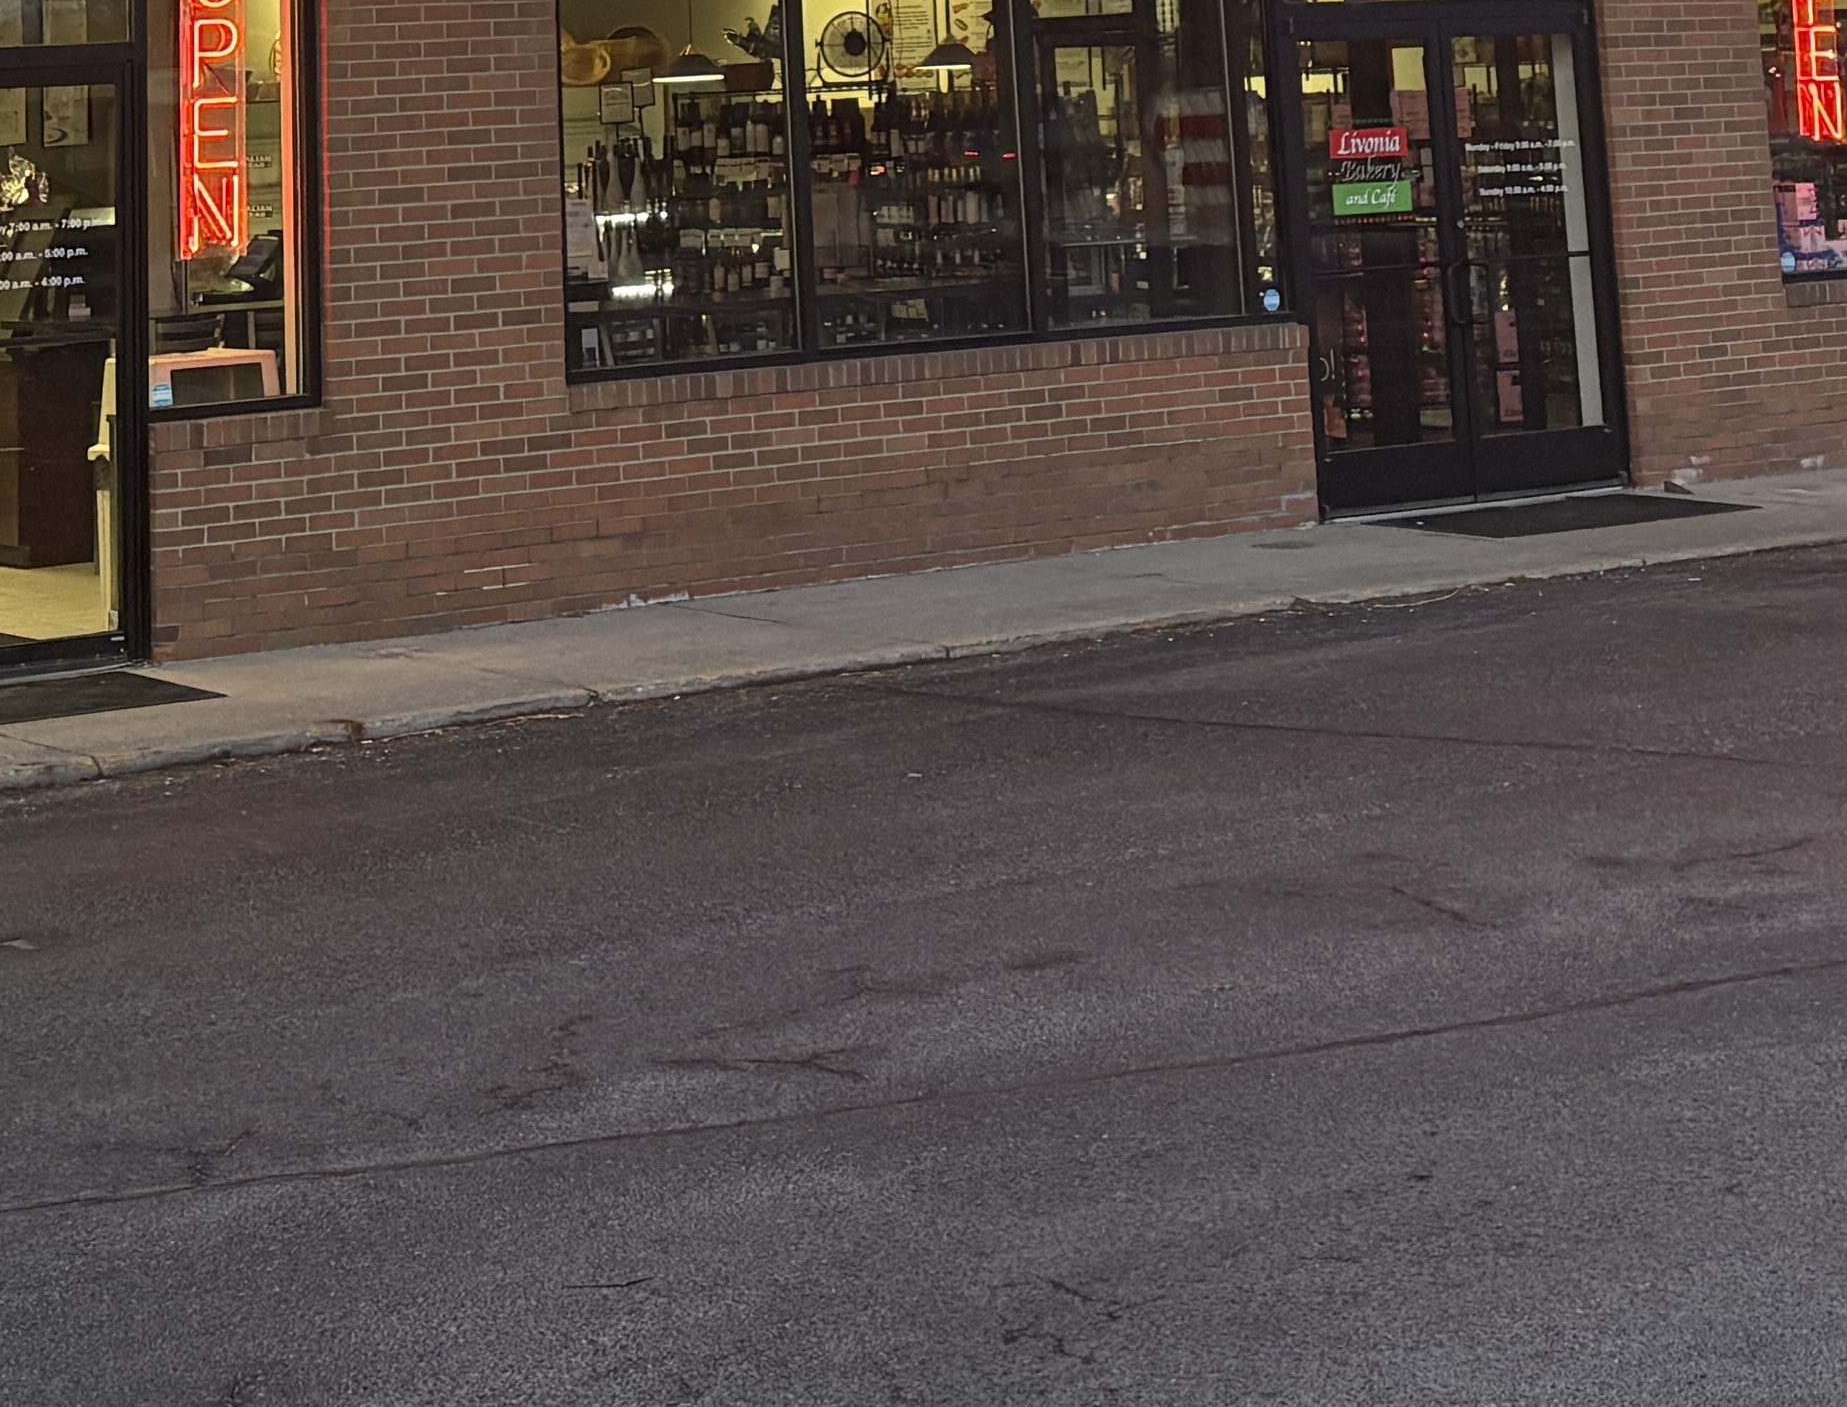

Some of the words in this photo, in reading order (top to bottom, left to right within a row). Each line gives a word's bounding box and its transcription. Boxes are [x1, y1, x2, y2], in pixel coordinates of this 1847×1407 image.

[1337, 129, 1401, 155] Livonia
[1341, 154, 1401, 190] Bakery
[1346, 188, 1370, 205] and
[1371, 188, 1398, 209] Café
[15, 252, 37, 261] a.m.
[66, 247, 89, 259] p.m.
[12, 280, 34, 289] a.m.
[64, 276, 86, 288] p.m.
